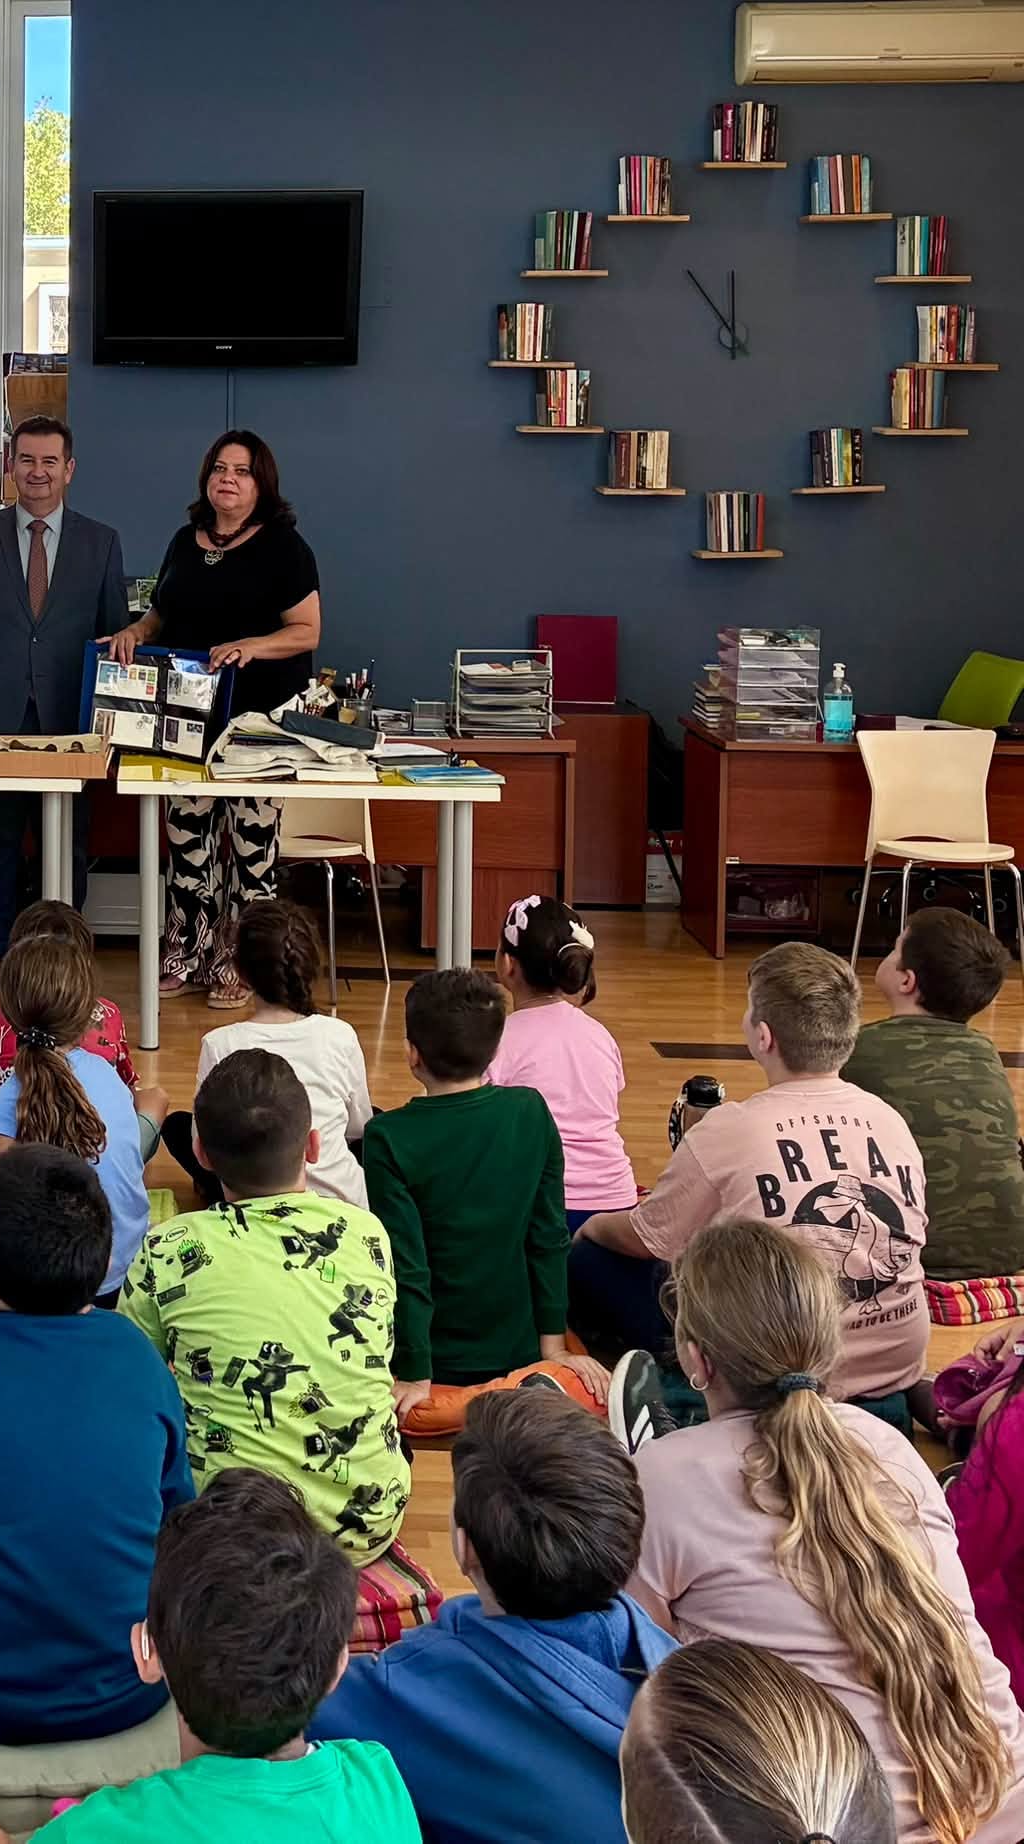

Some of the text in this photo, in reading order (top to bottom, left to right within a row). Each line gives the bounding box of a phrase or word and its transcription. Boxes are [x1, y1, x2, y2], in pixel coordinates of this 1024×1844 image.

[776, 1114, 872, 1132] OFFSHORE
[755, 1129, 917, 1218] BREAK
[865, 1316, 877, 1327] TO
[879, 1312, 892, 1323] BE
[893, 1298, 918, 1320] THERE
